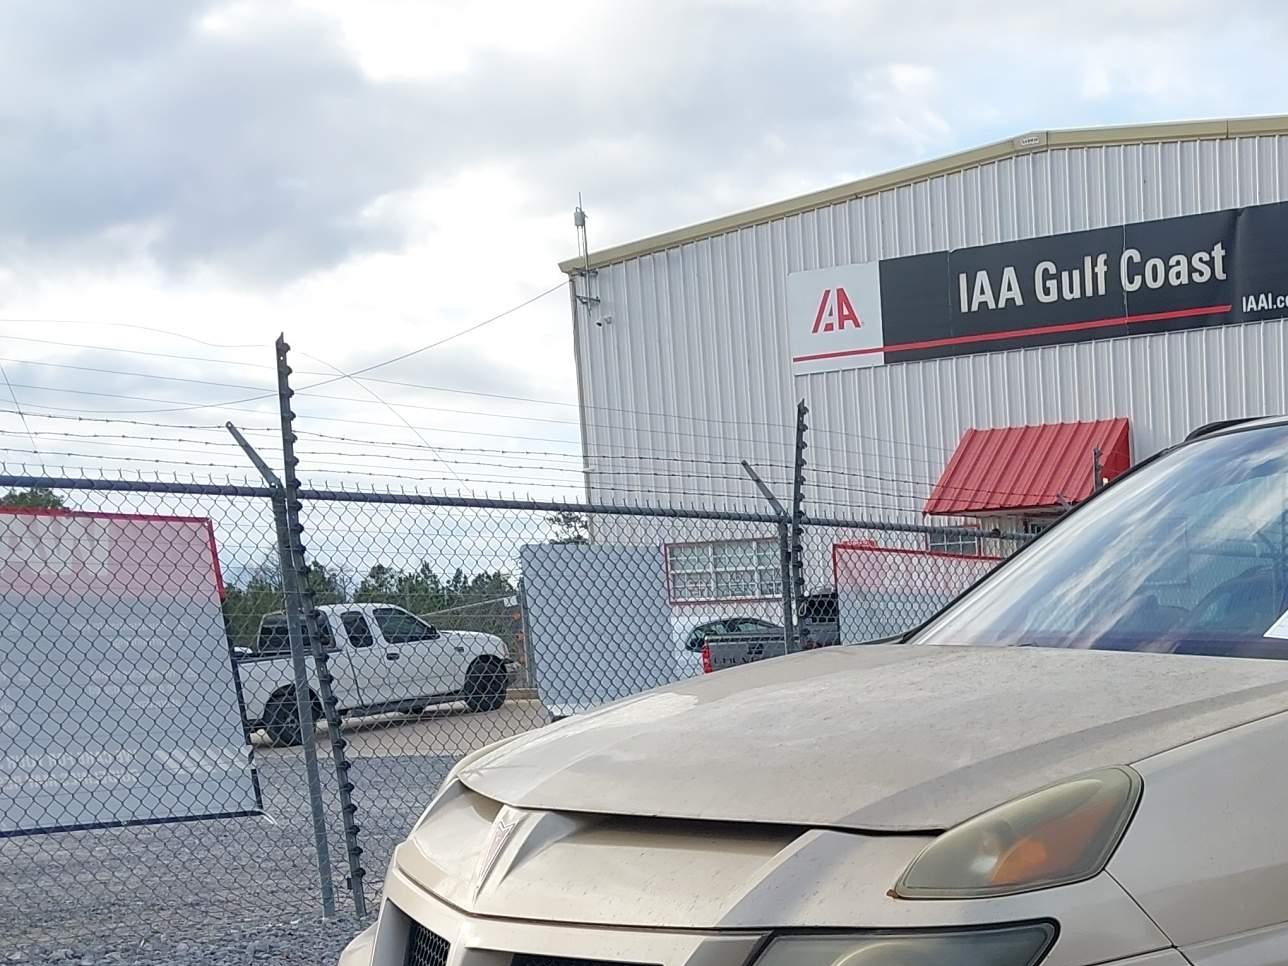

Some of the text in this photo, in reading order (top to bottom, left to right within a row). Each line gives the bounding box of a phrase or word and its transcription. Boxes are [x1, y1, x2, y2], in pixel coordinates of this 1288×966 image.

[959, 241, 1227, 313] IAA Gulf Coast
